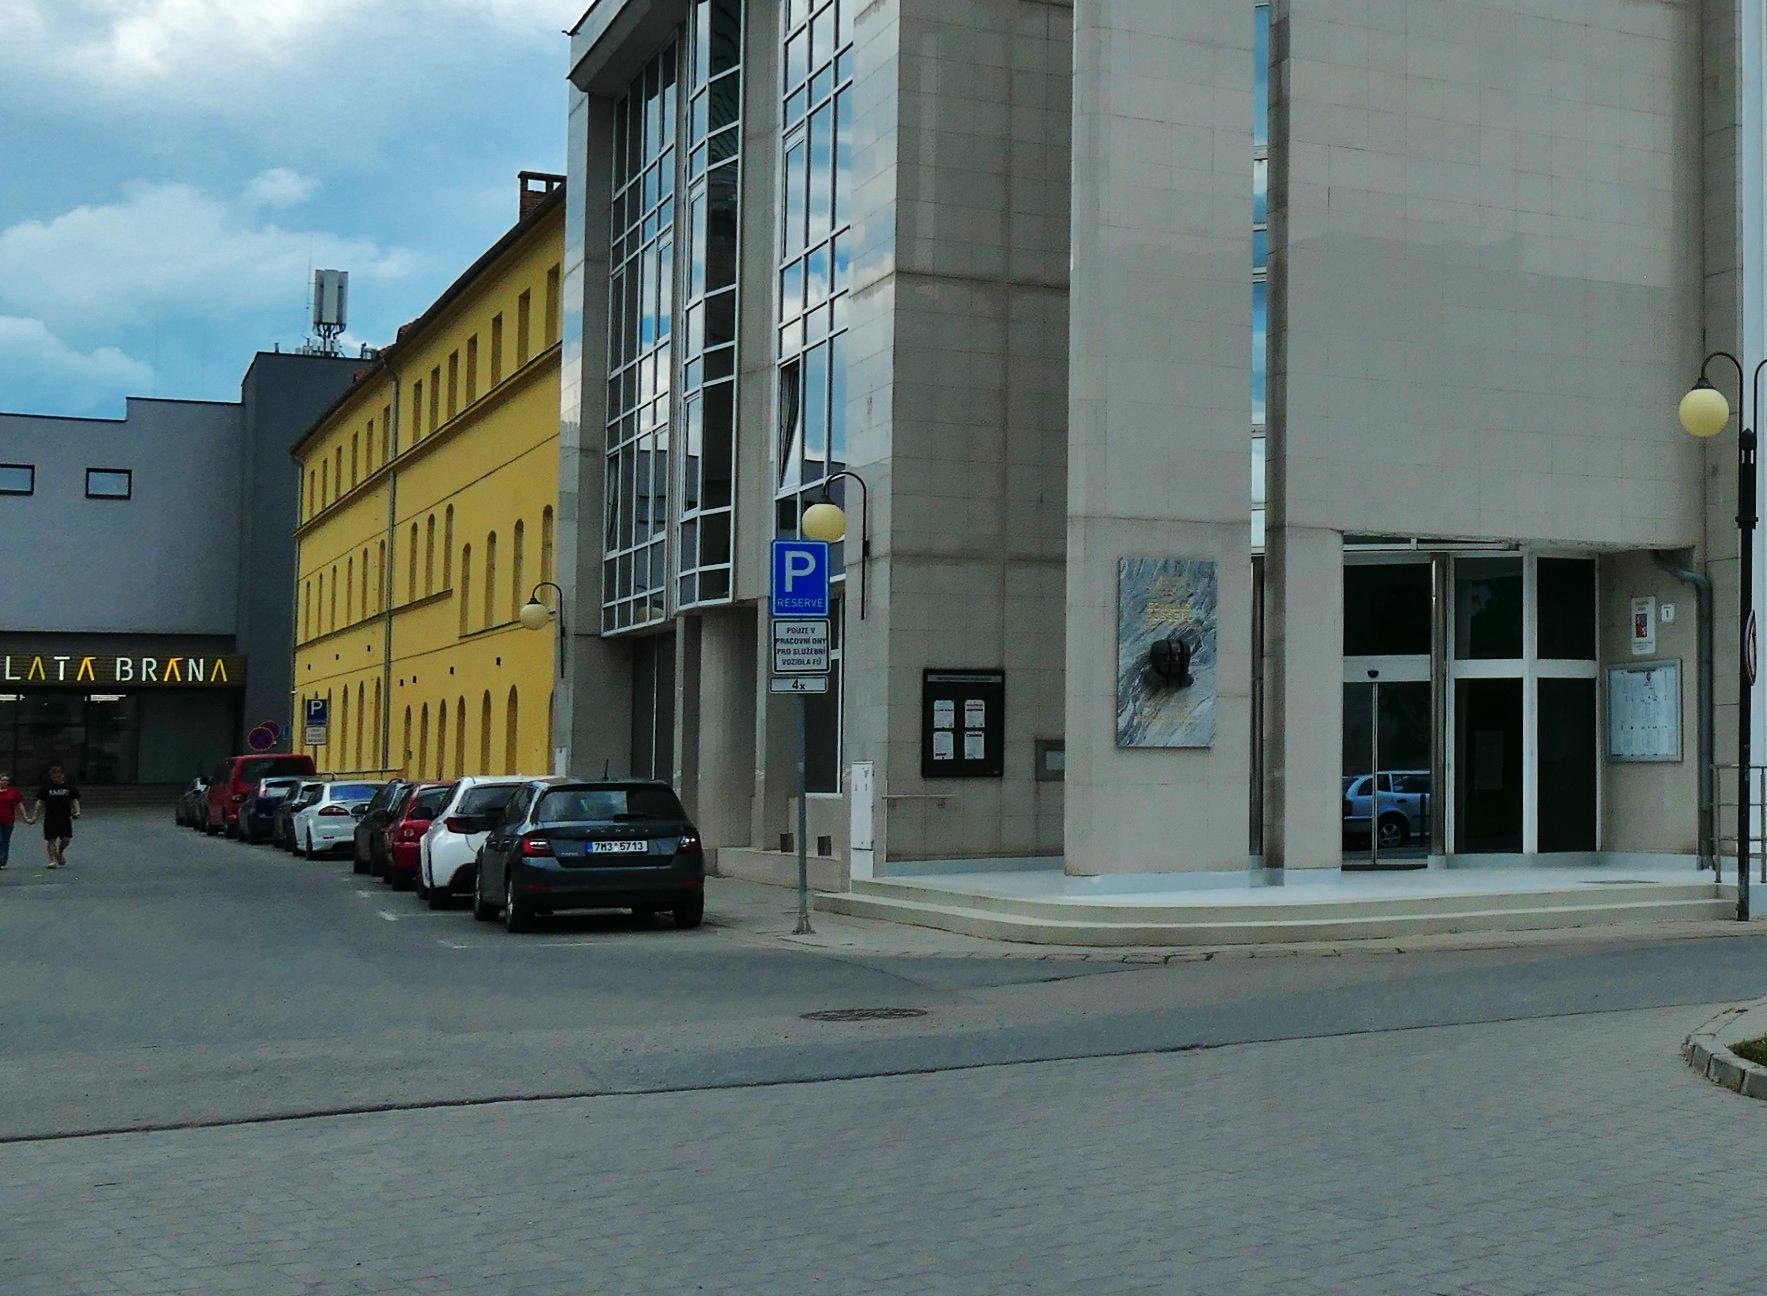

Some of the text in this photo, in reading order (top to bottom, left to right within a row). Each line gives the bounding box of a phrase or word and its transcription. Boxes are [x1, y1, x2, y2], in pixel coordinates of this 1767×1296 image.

[784, 550, 816, 593] P
[775, 636, 811, 645] PRACOVNÍ
[781, 658, 811, 666] VOZIDLA
[115, 656, 228, 682] BRÁNA
[311, 700, 323, 715] P
[620, 841, 644, 851] 5713
